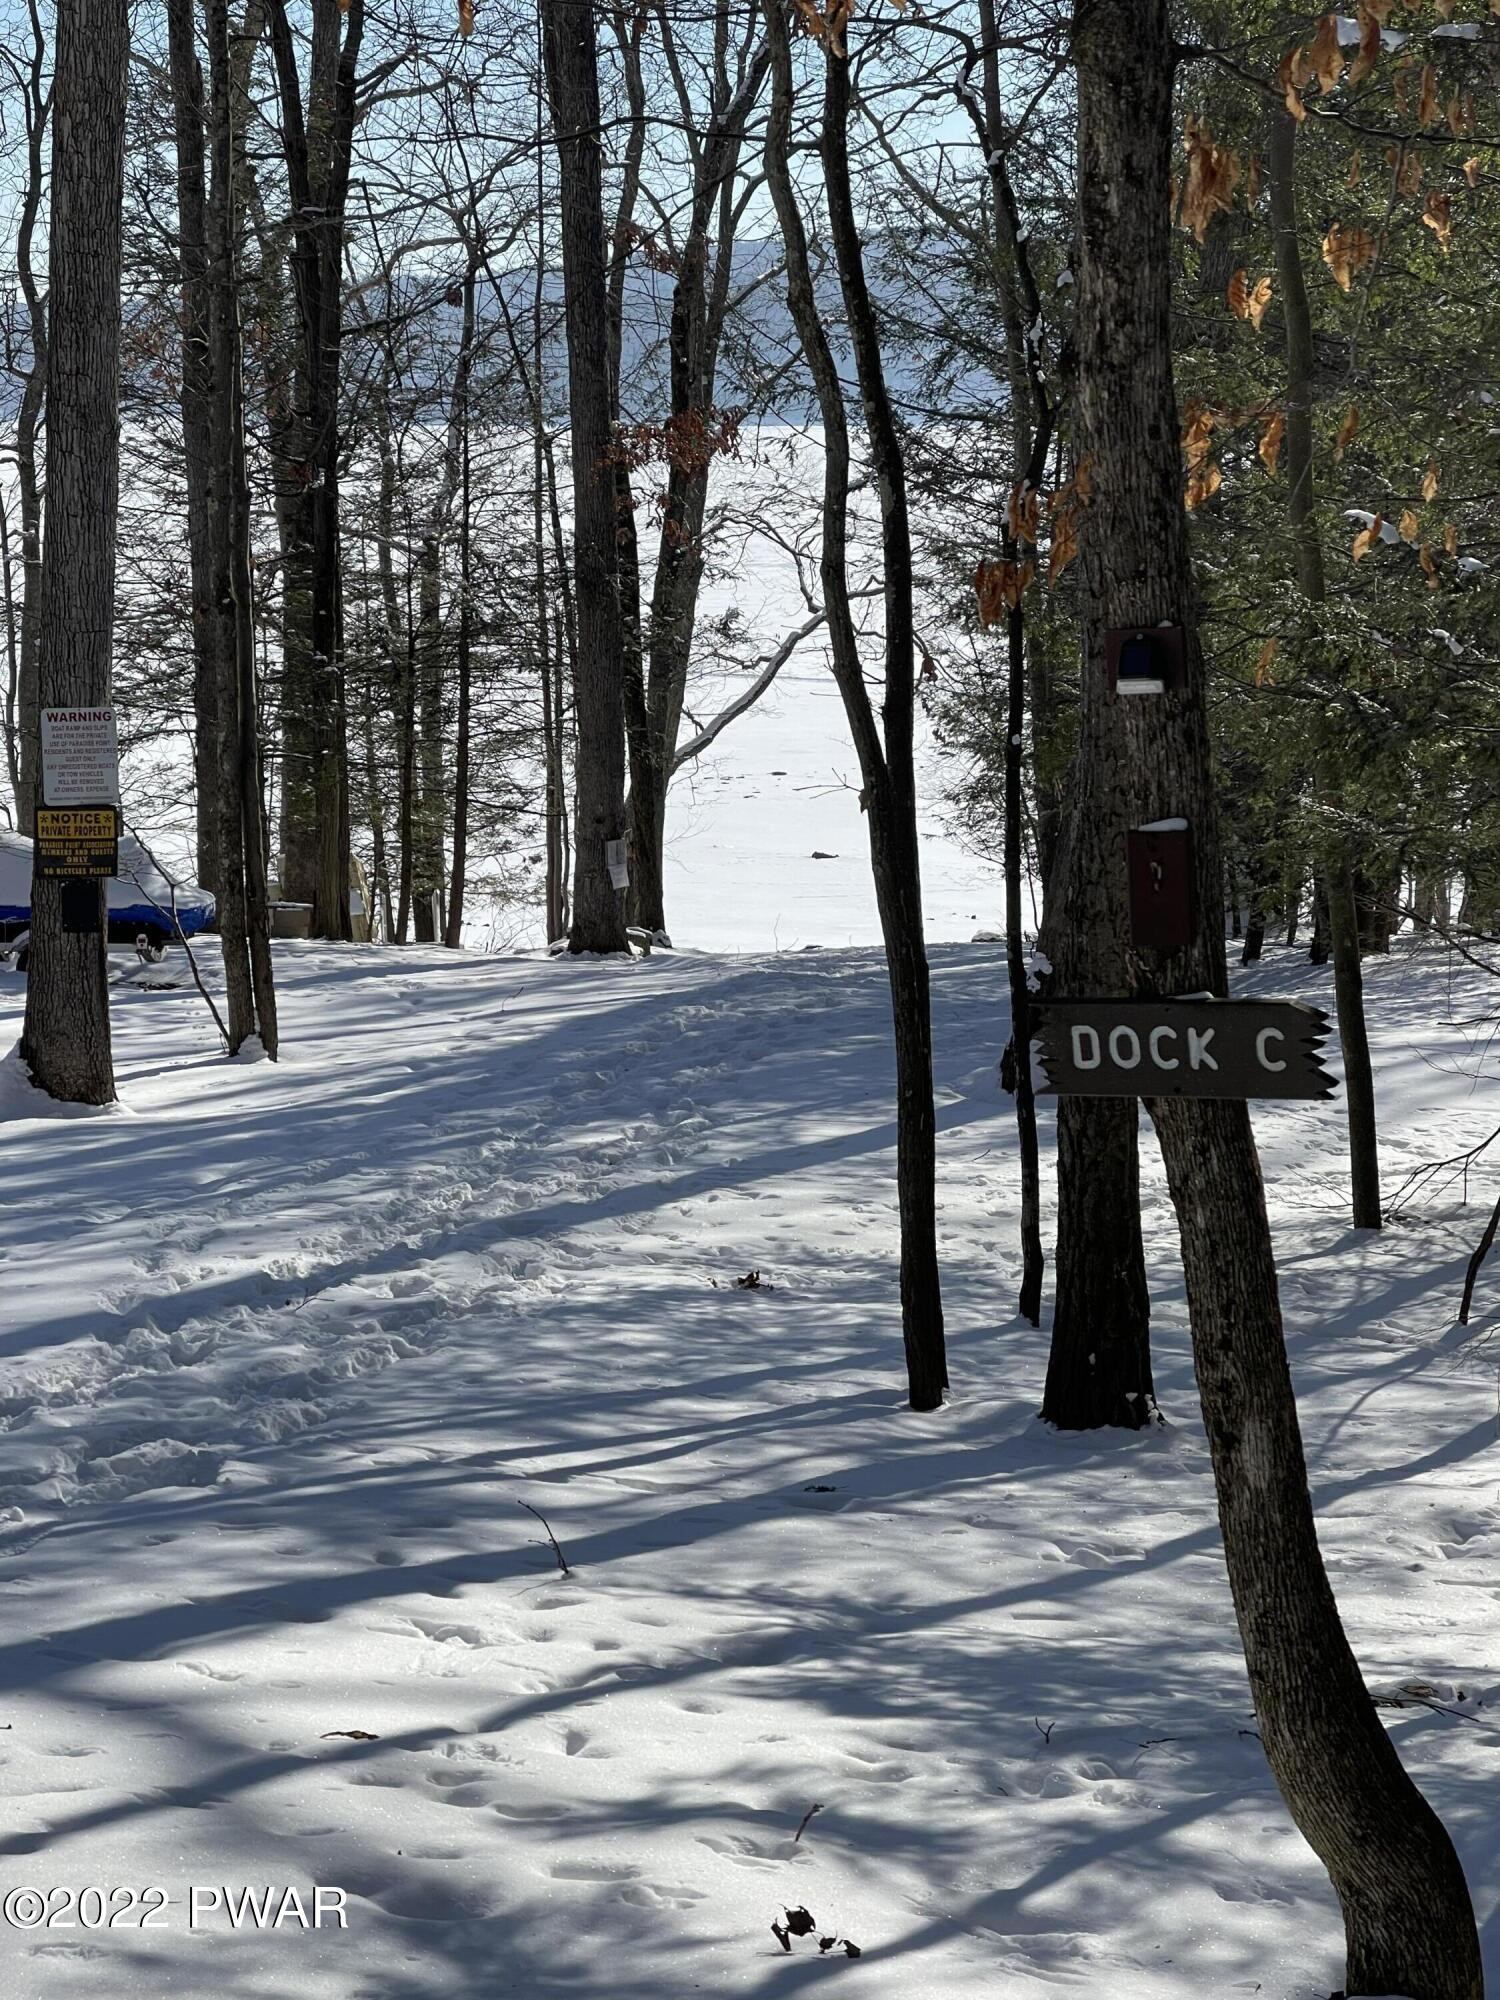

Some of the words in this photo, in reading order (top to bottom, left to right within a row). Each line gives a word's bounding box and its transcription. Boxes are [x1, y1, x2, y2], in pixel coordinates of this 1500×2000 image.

[47, 712, 111, 722] WARNING
[51, 814, 100, 824] NOTICE
[41, 826, 71, 836] PRIVATE
[74, 826, 111, 836] PROPERTY
[1071, 1025, 1219, 1071] DOCK
[1256, 1027, 1287, 1072] C
